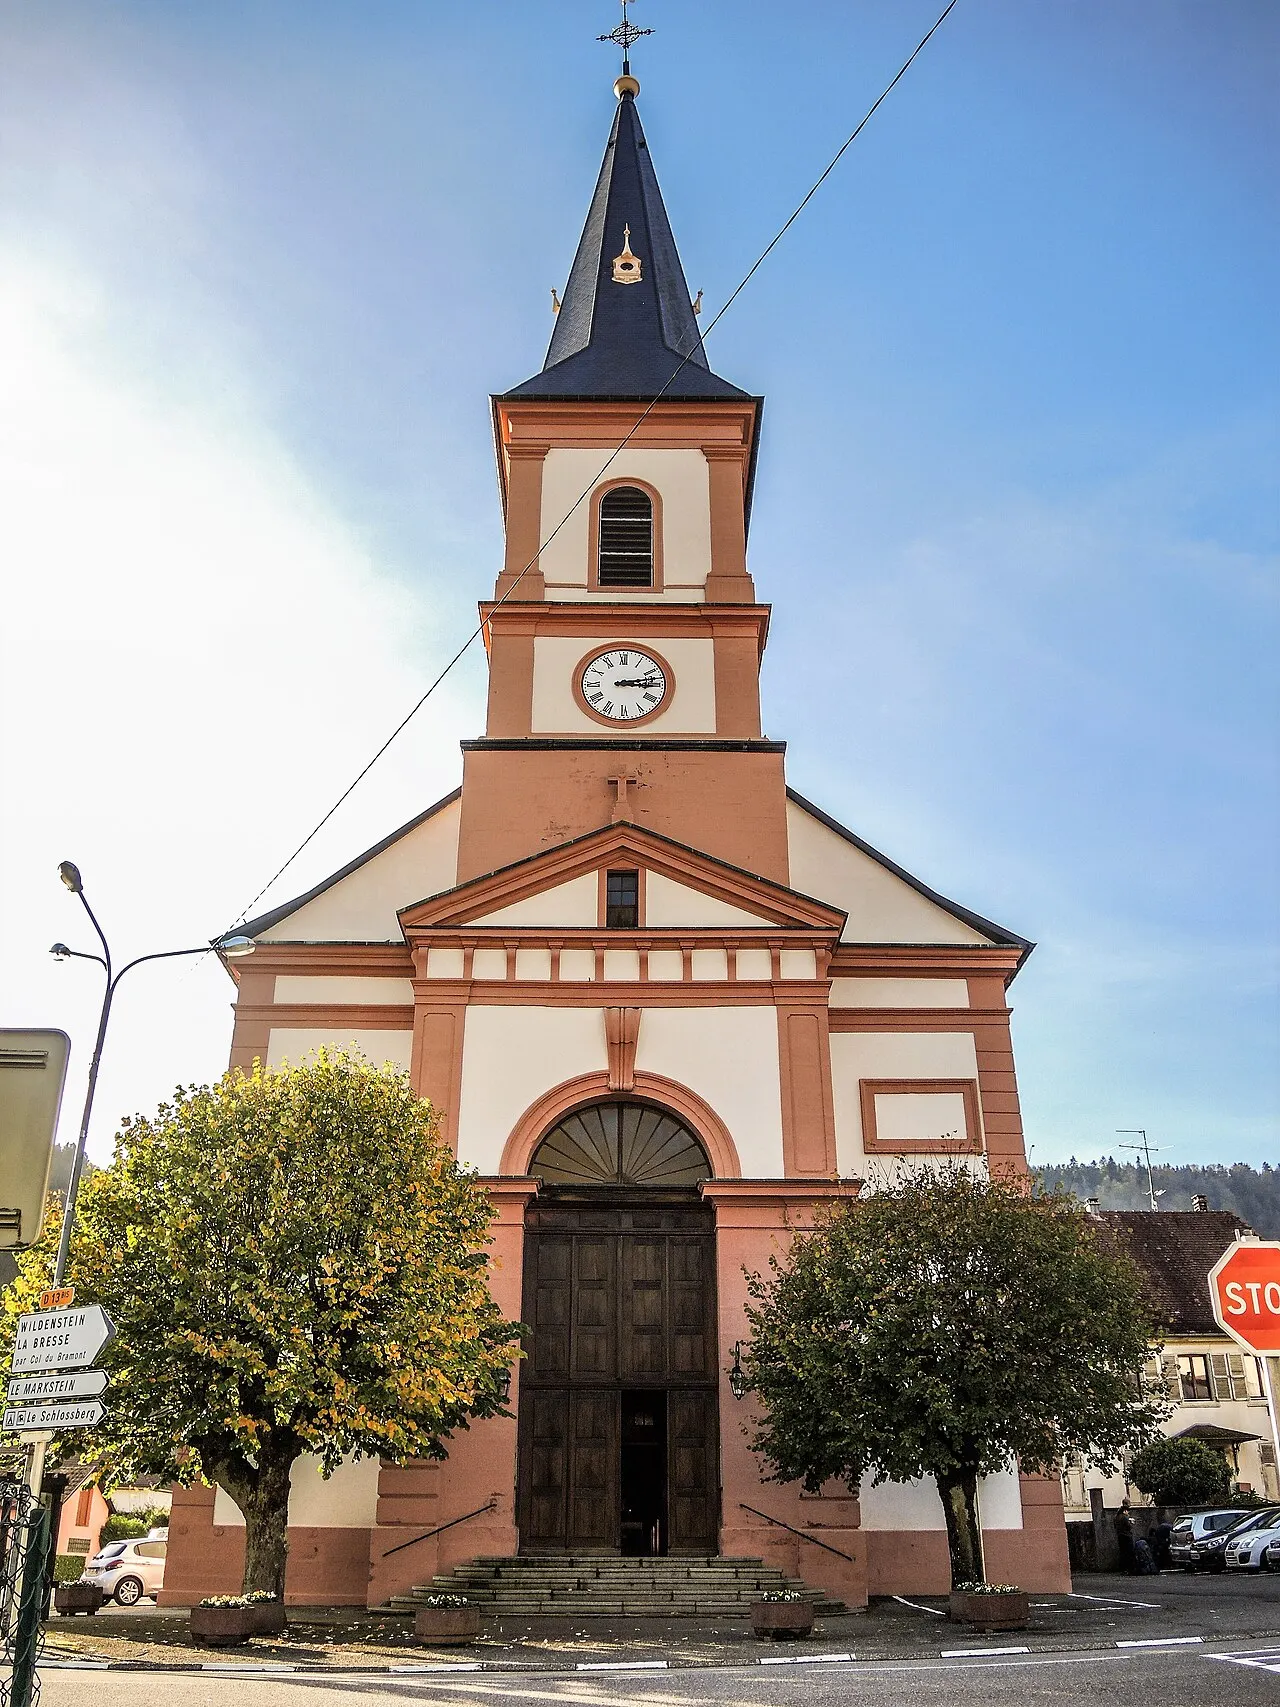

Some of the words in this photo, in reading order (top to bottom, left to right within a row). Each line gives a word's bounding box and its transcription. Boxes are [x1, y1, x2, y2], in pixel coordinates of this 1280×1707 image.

[43, 1294, 50, 1305] D
[21, 1314, 86, 1333] WILDENSTEIN
[17, 1339, 28, 1351] LA
[33, 1333, 70, 1349] BRESSE
[14, 1357, 27, 1368] par
[30, 1354, 42, 1365] Col
[45, 1353, 54, 1363] du
[57, 1350, 87, 1362] Bramont
[10, 1384, 21, 1396] LE
[23, 1379, 76, 1395] MARKSTEIN
[26, 1411, 37, 1423] Le
[40, 1408, 96, 1422] Schlossberg
